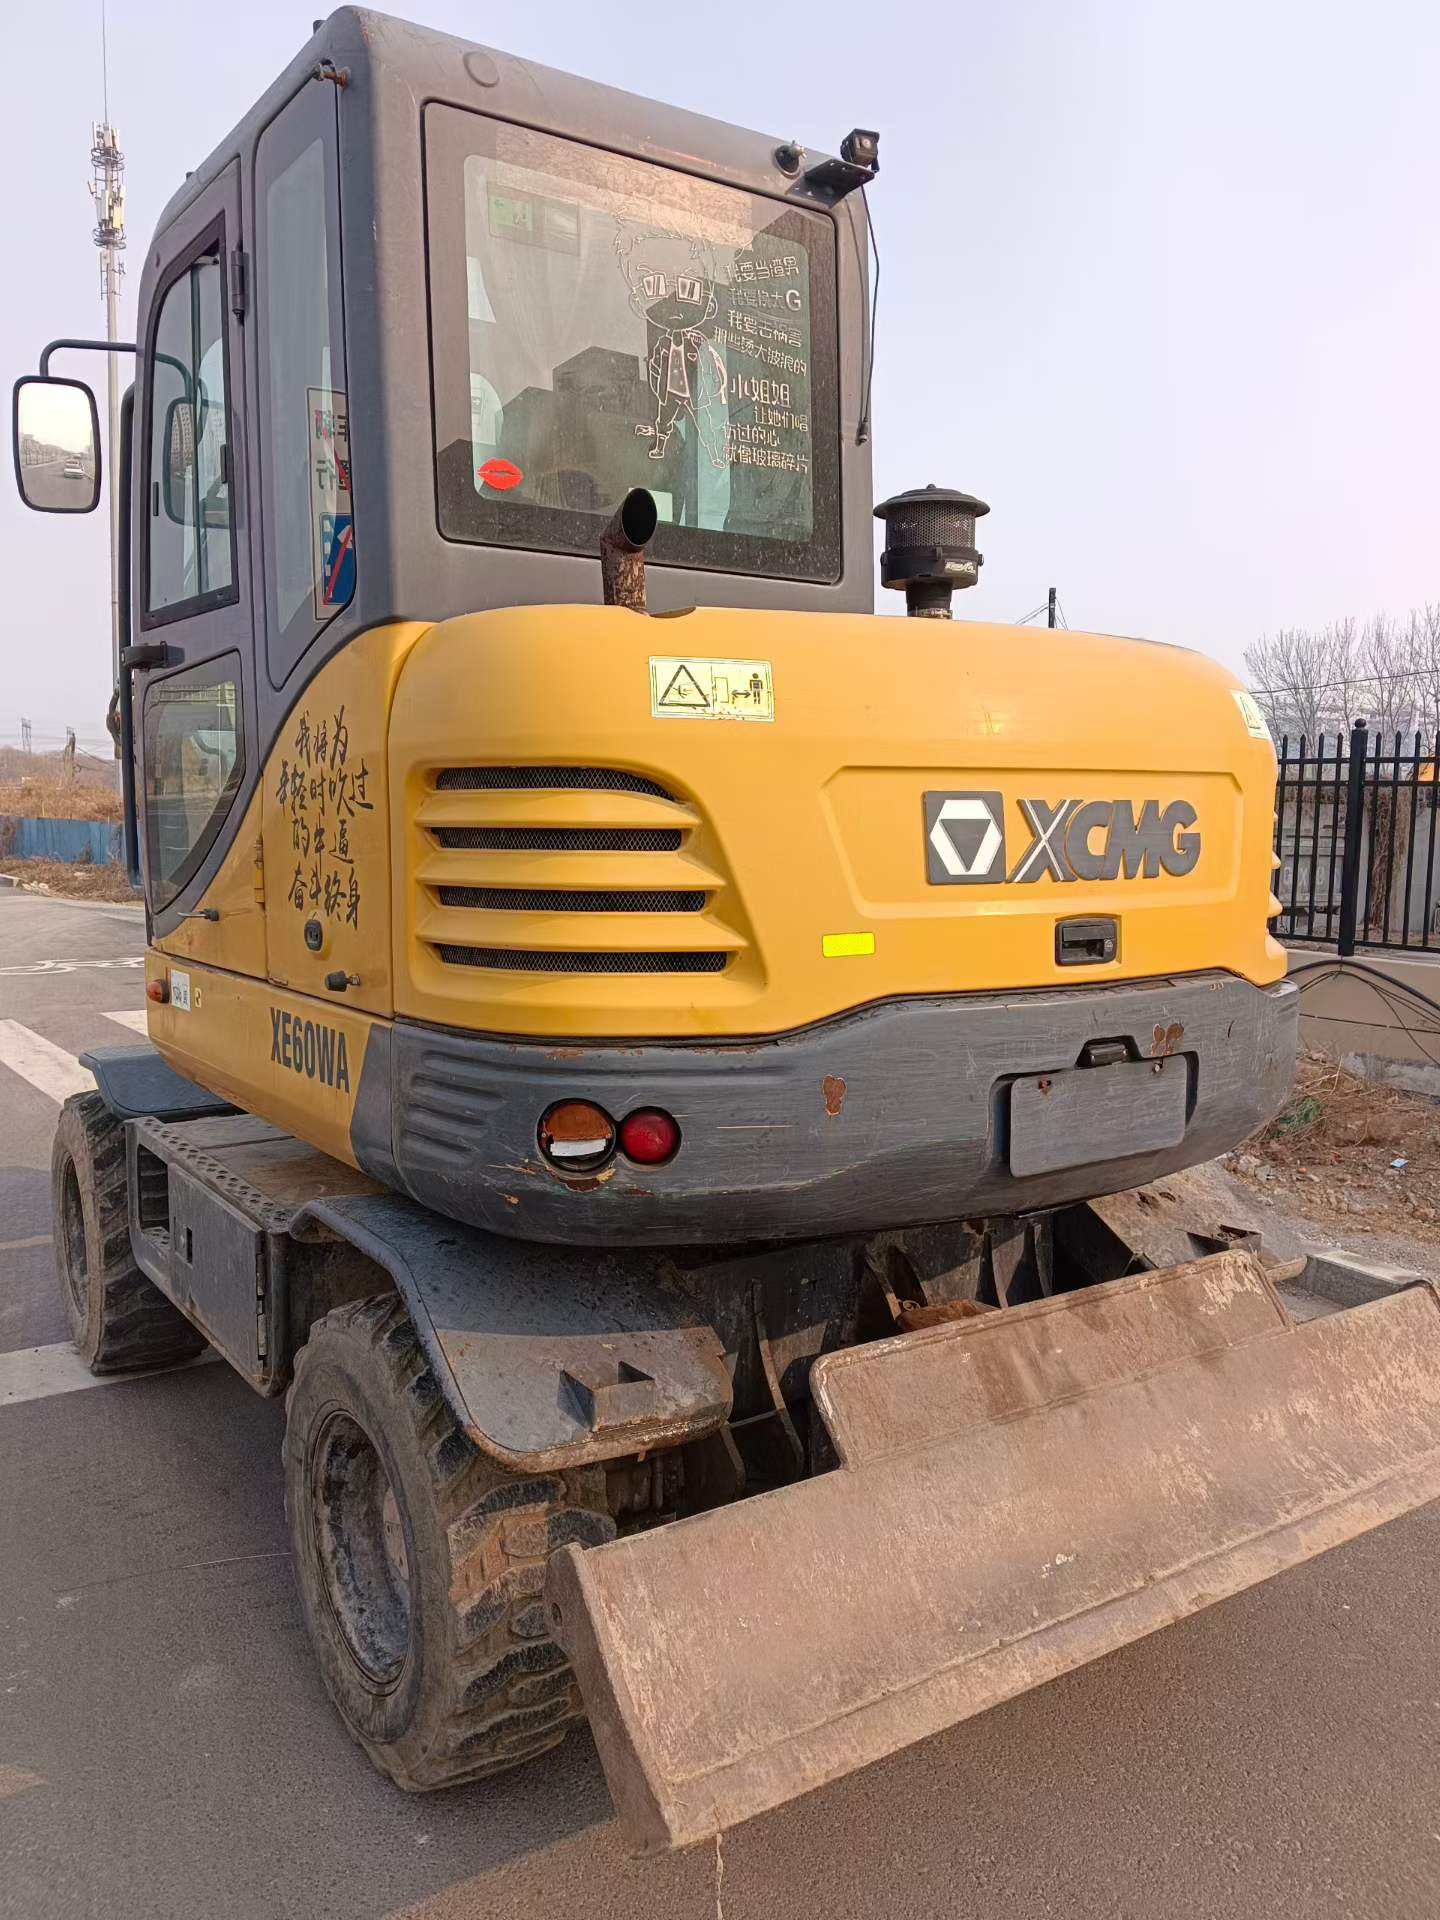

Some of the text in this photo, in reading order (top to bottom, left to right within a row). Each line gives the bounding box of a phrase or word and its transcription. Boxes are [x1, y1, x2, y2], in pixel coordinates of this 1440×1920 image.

[730, 373, 791, 408] 小姐姐
[1004, 798, 1201, 884] XCMG
[270, 1006, 350, 1094] XE60WA
